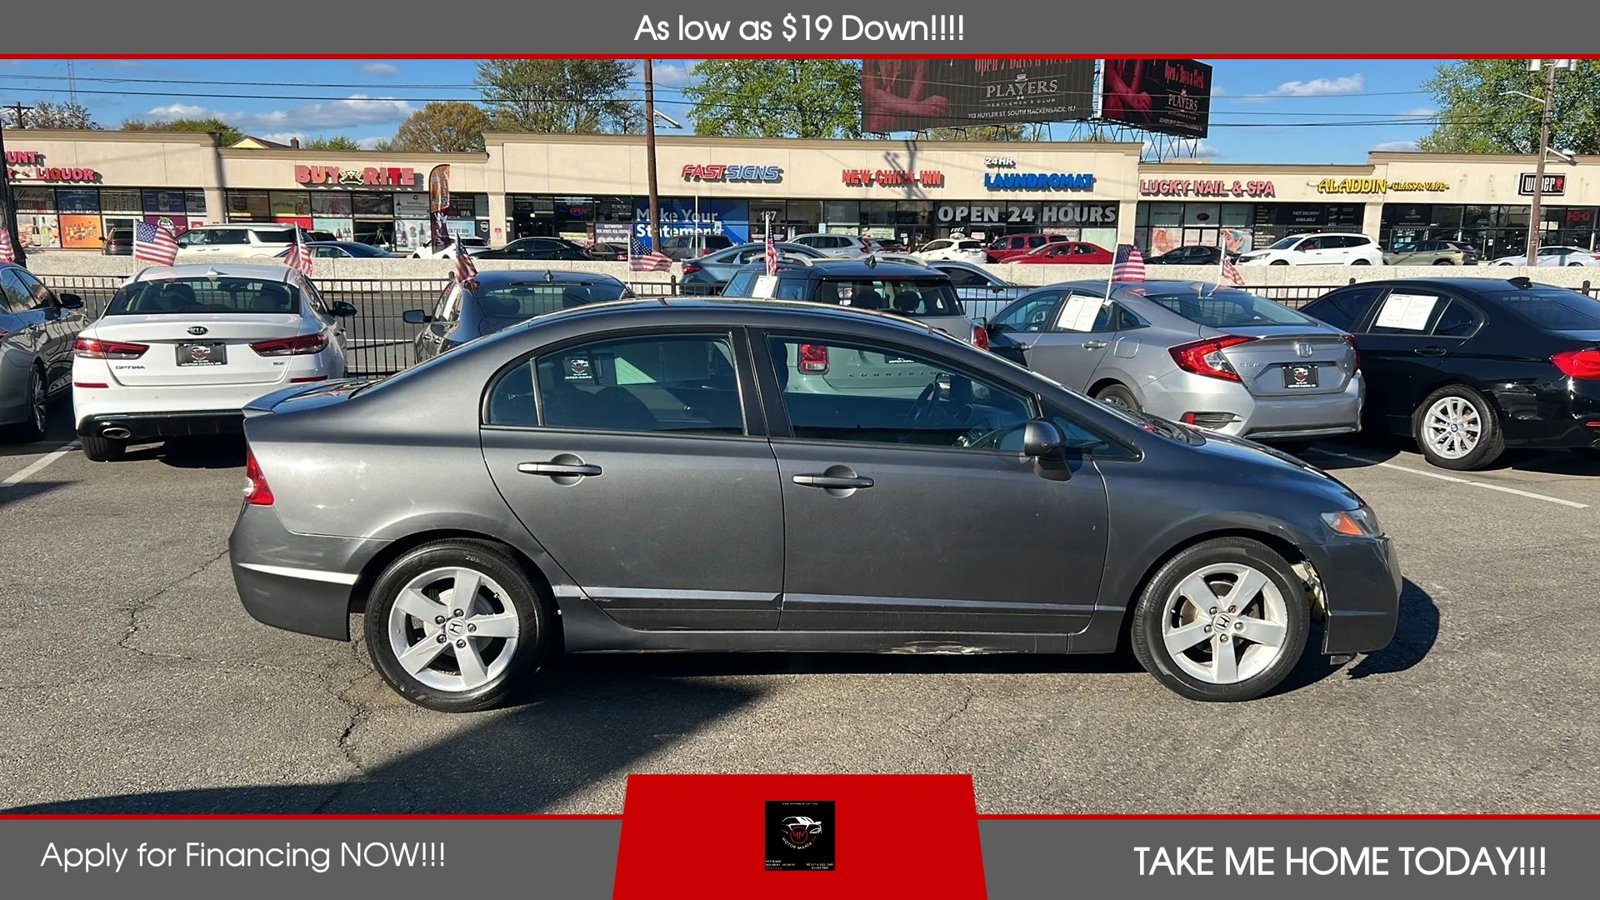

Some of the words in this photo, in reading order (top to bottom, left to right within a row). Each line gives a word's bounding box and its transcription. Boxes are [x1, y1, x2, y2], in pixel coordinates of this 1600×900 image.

[987, 79, 1058, 98] PLAYERS
[1168, 94, 1198, 112] PLAYERS
[36, 167, 95, 181] LIQUOR
[294, 165, 340, 184] BUY
[363, 167, 416, 186] RITE
[681, 164, 779, 181] FASTSIGNS
[842, 169, 871, 184] NEW
[874, 169, 915, 184] CHINA
[919, 169, 942, 184] INN
[984, 173, 1094, 189] LAUNDROMAT
[1139, 179, 1190, 194] LUCKY
[1193, 180, 1228, 195] NAIL
[1232, 181, 1243, 194] &
[1246, 181, 1275, 195] SPA
[1317, 178, 1388, 194] ALADDIN
[1525, 176, 1555, 192] wer
[636, 207, 678, 222] Mke
[681, 208, 719, 222] Your
[760, 210, 777, 222] 187
[937, 206, 1000, 222] OPEN
[1007, 206, 1035, 222] 24
[1042, 206, 1117, 222] HOURS
[636, 223, 724, 238] Sttemen
